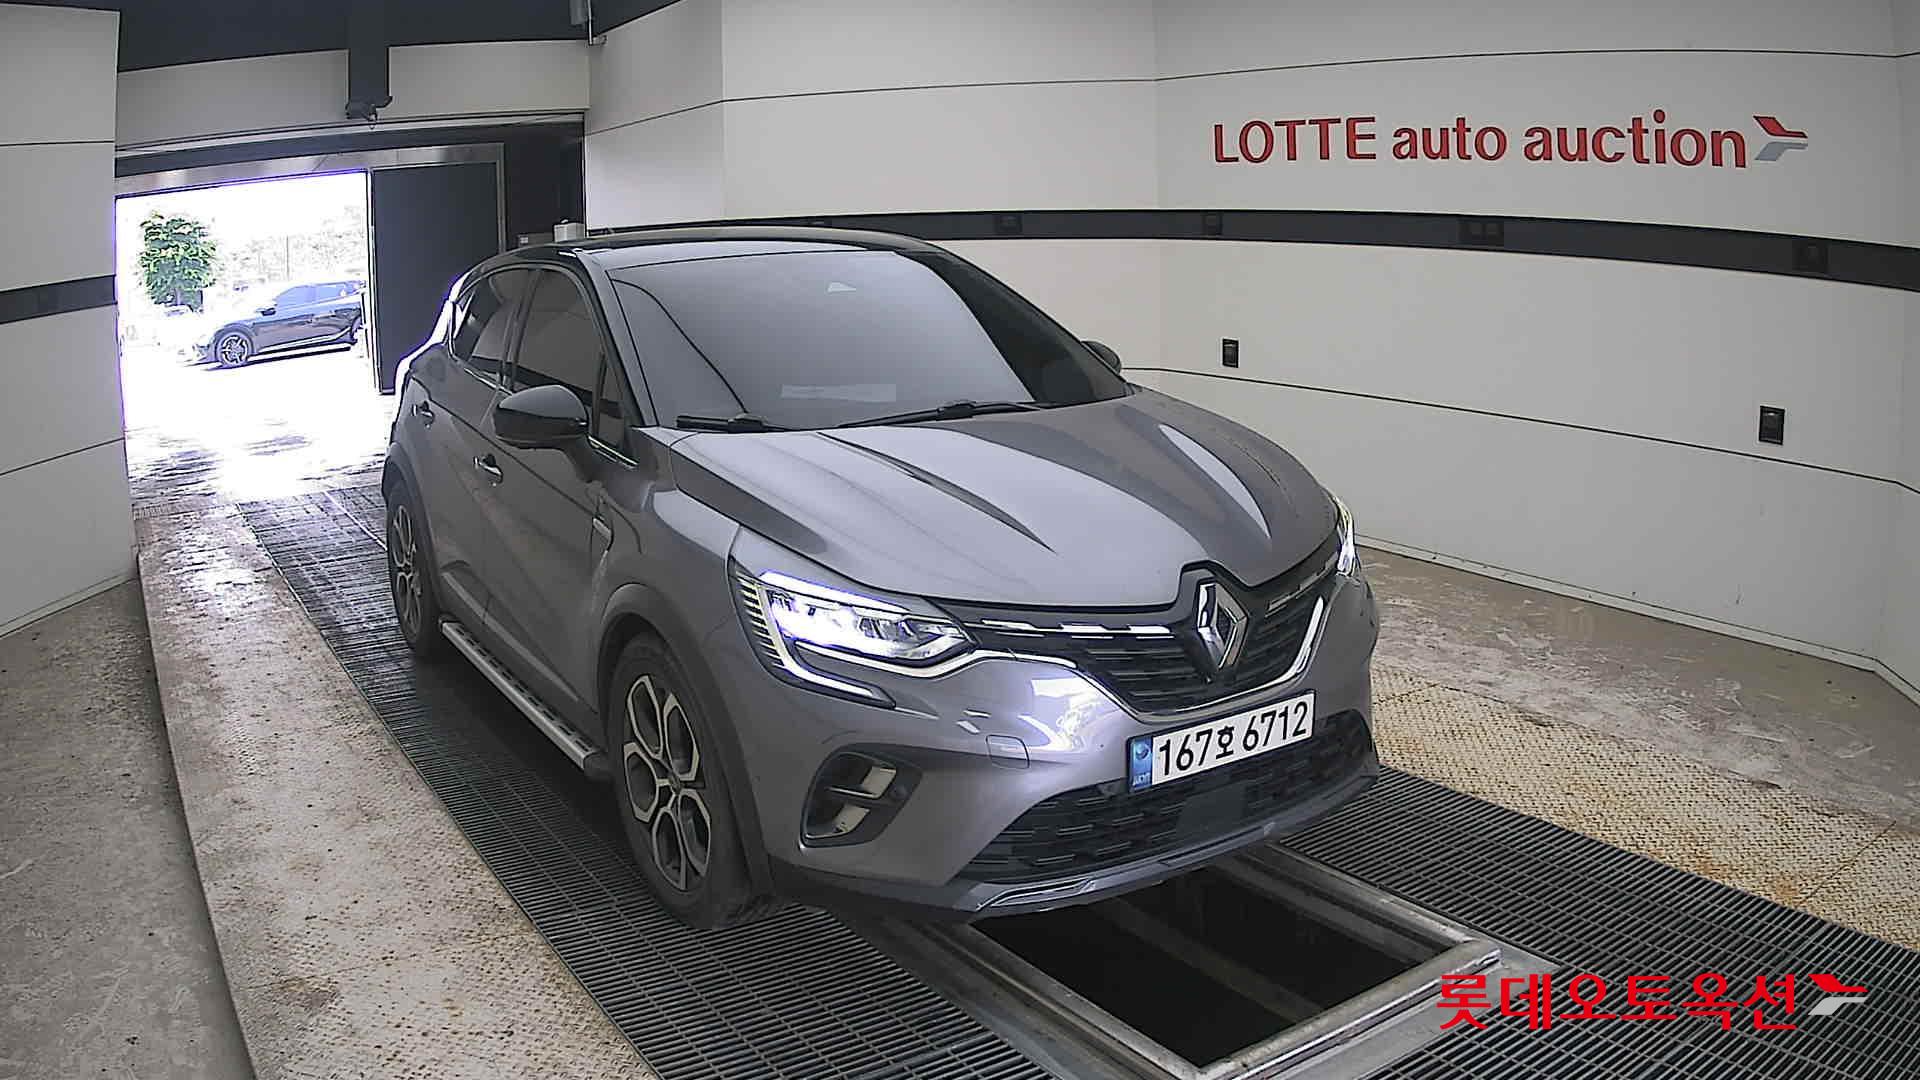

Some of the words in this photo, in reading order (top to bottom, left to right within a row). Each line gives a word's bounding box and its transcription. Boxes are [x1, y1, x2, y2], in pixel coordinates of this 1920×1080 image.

[1213, 116, 1377, 164] LOTTE
[1392, 116, 1508, 161] auto
[1523, 109, 1747, 168] auction
[1159, 726, 1235, 776] 167호
[1243, 701, 1308, 752] 6712
